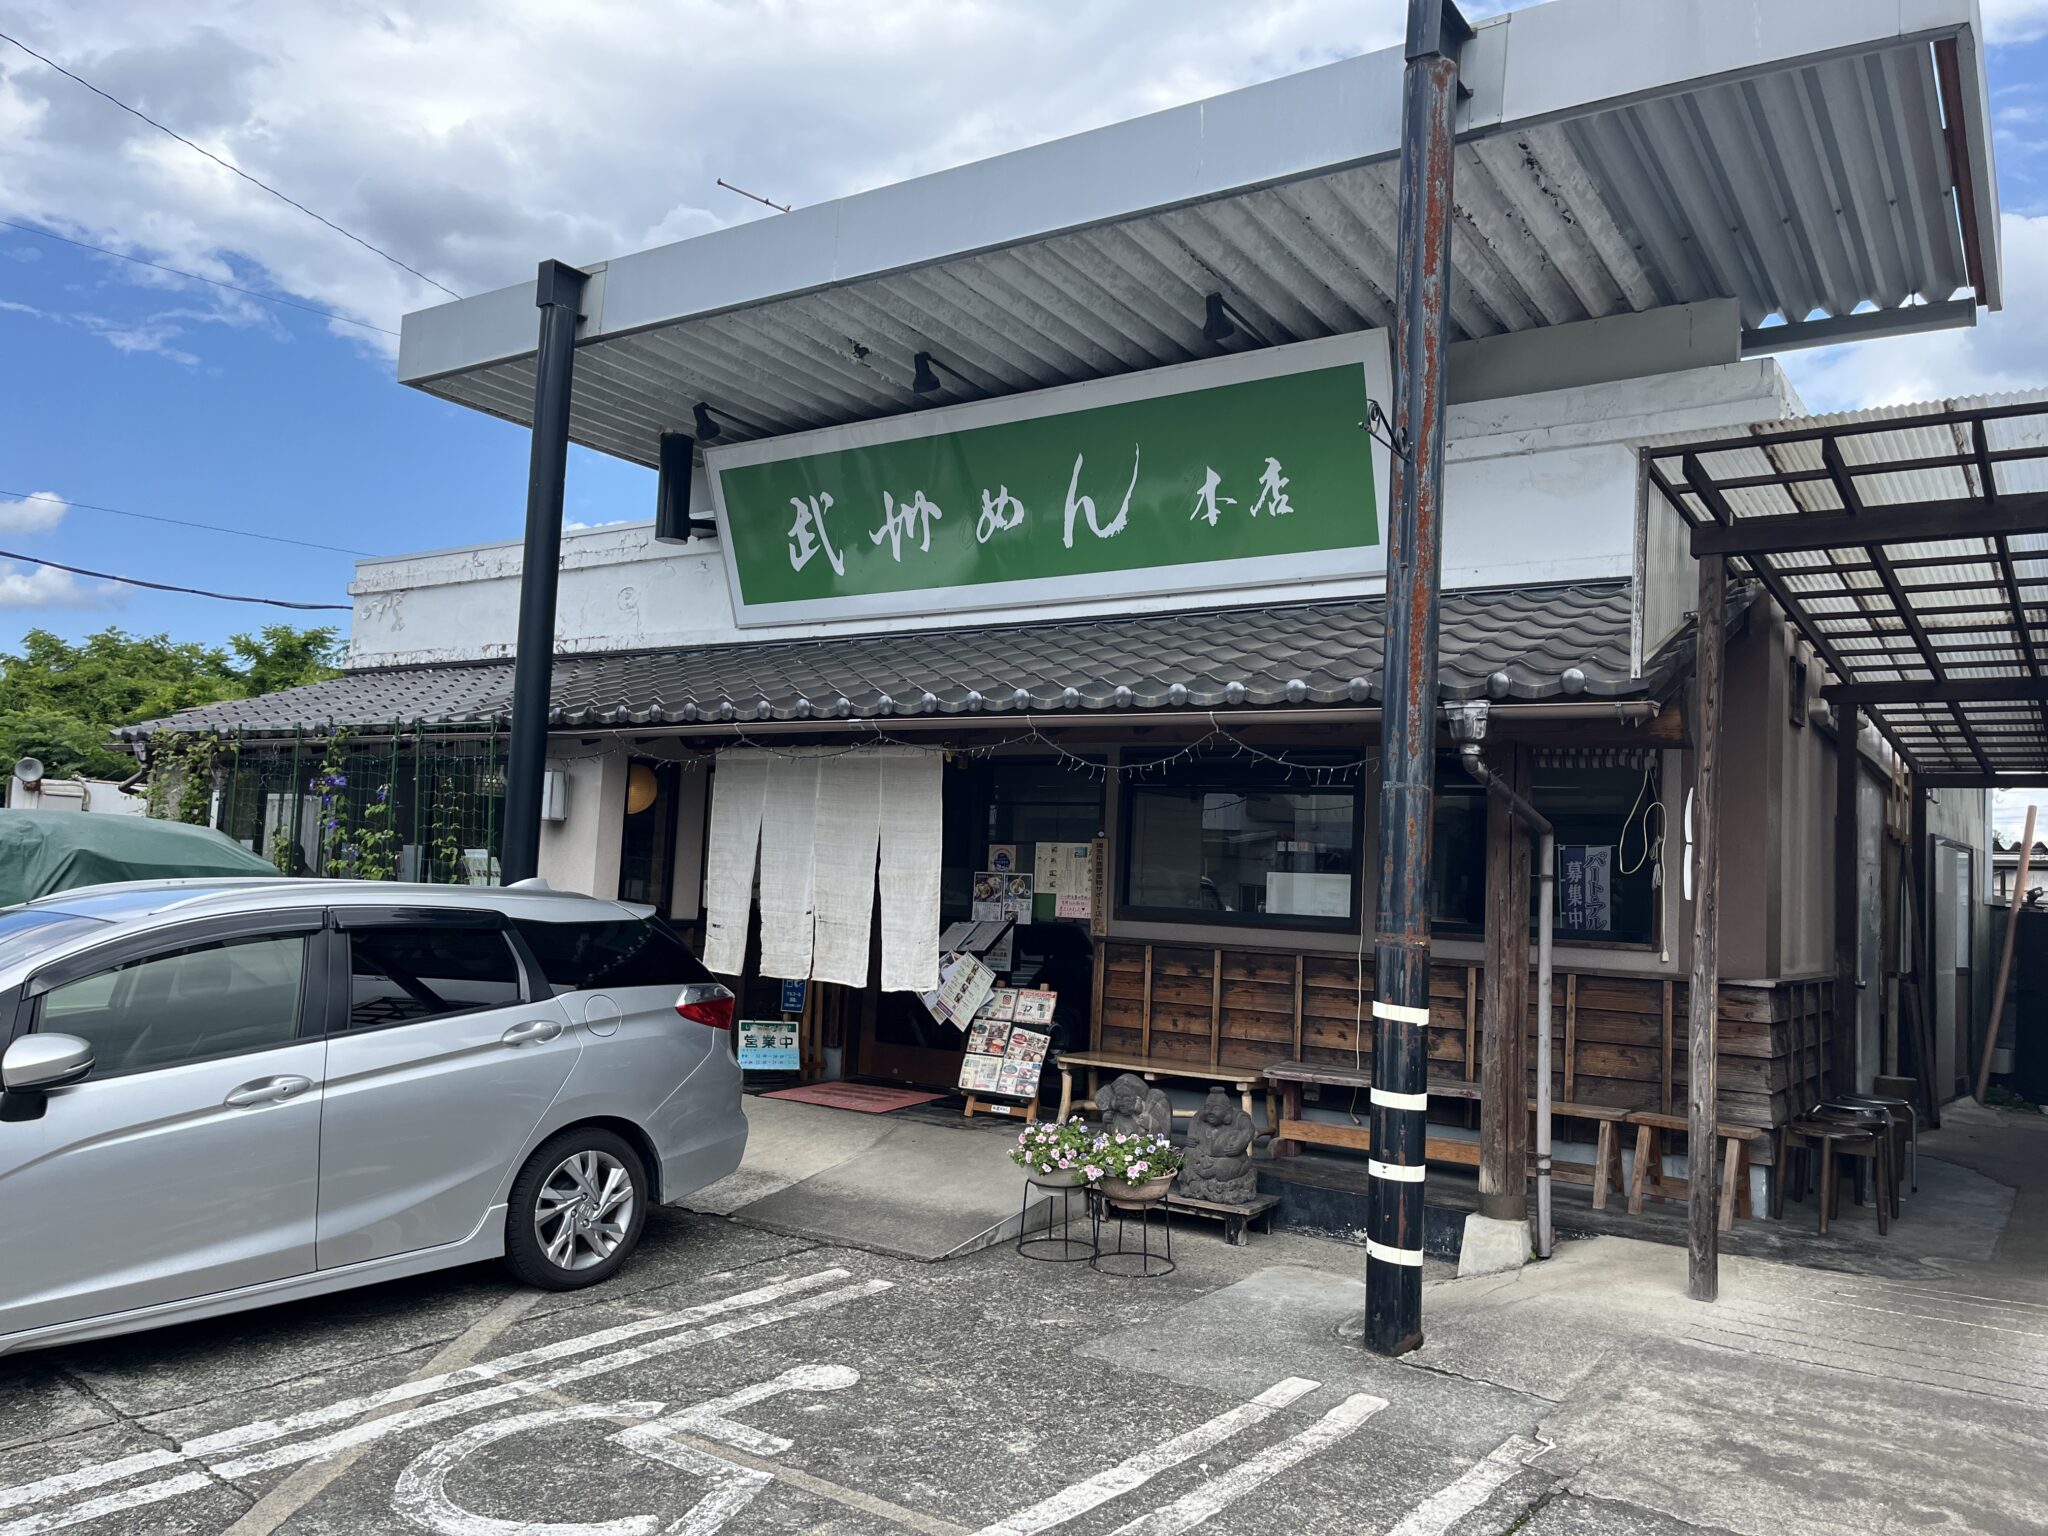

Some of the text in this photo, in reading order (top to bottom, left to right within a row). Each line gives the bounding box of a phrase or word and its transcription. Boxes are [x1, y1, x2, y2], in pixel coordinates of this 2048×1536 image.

[788, 442, 1294, 577] 武州めん 本店
[1566, 861, 1583, 930] 募集中
[744, 1034, 793, 1049] 営業中
